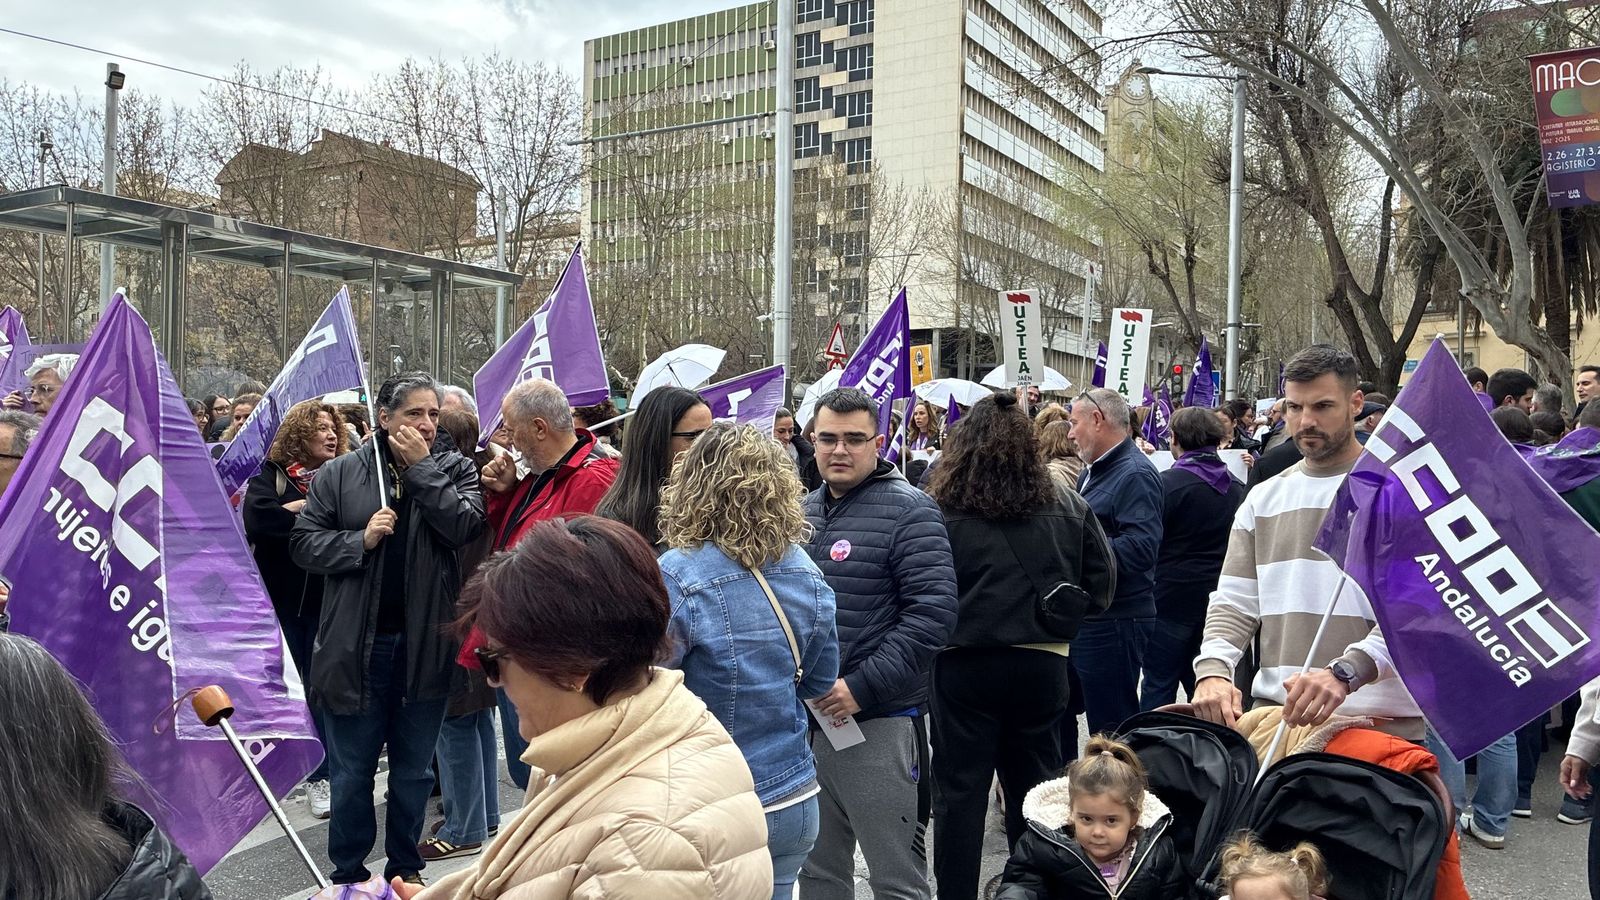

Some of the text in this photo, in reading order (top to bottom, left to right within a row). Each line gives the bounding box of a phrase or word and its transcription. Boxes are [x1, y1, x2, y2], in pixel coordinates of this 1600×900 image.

[1014, 305, 1030, 374] USTEA
[1117, 324, 1136, 396] USTEA
[109, 584, 131, 612] e
[1414, 552, 1532, 688] Andalucía
